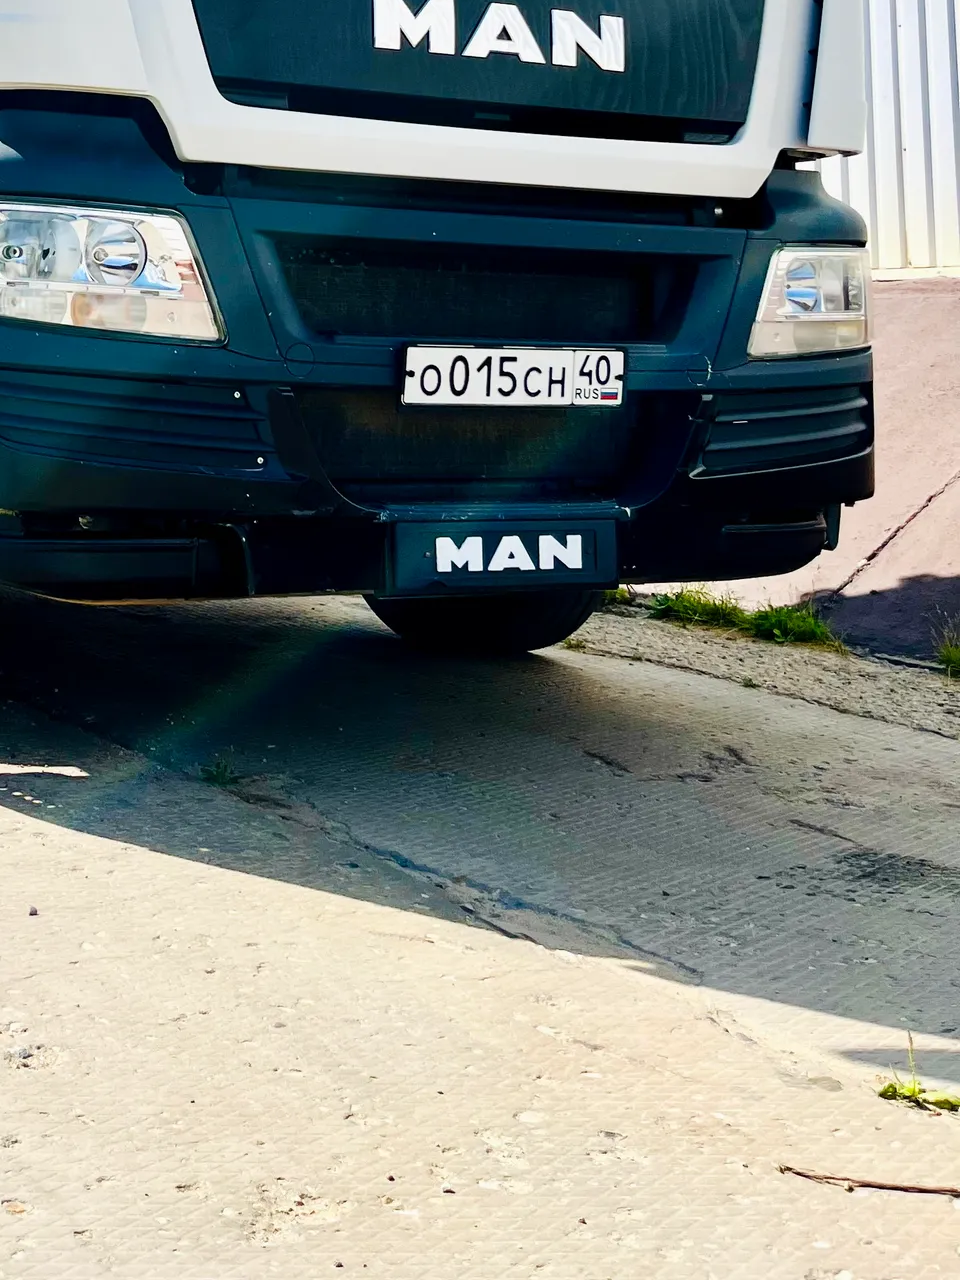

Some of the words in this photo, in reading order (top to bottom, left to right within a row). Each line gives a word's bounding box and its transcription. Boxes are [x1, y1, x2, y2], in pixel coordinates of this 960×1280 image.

[579, 355, 611, 385] 40
[574, 388, 599, 400] RUS
[435, 534, 583, 573] MAN
